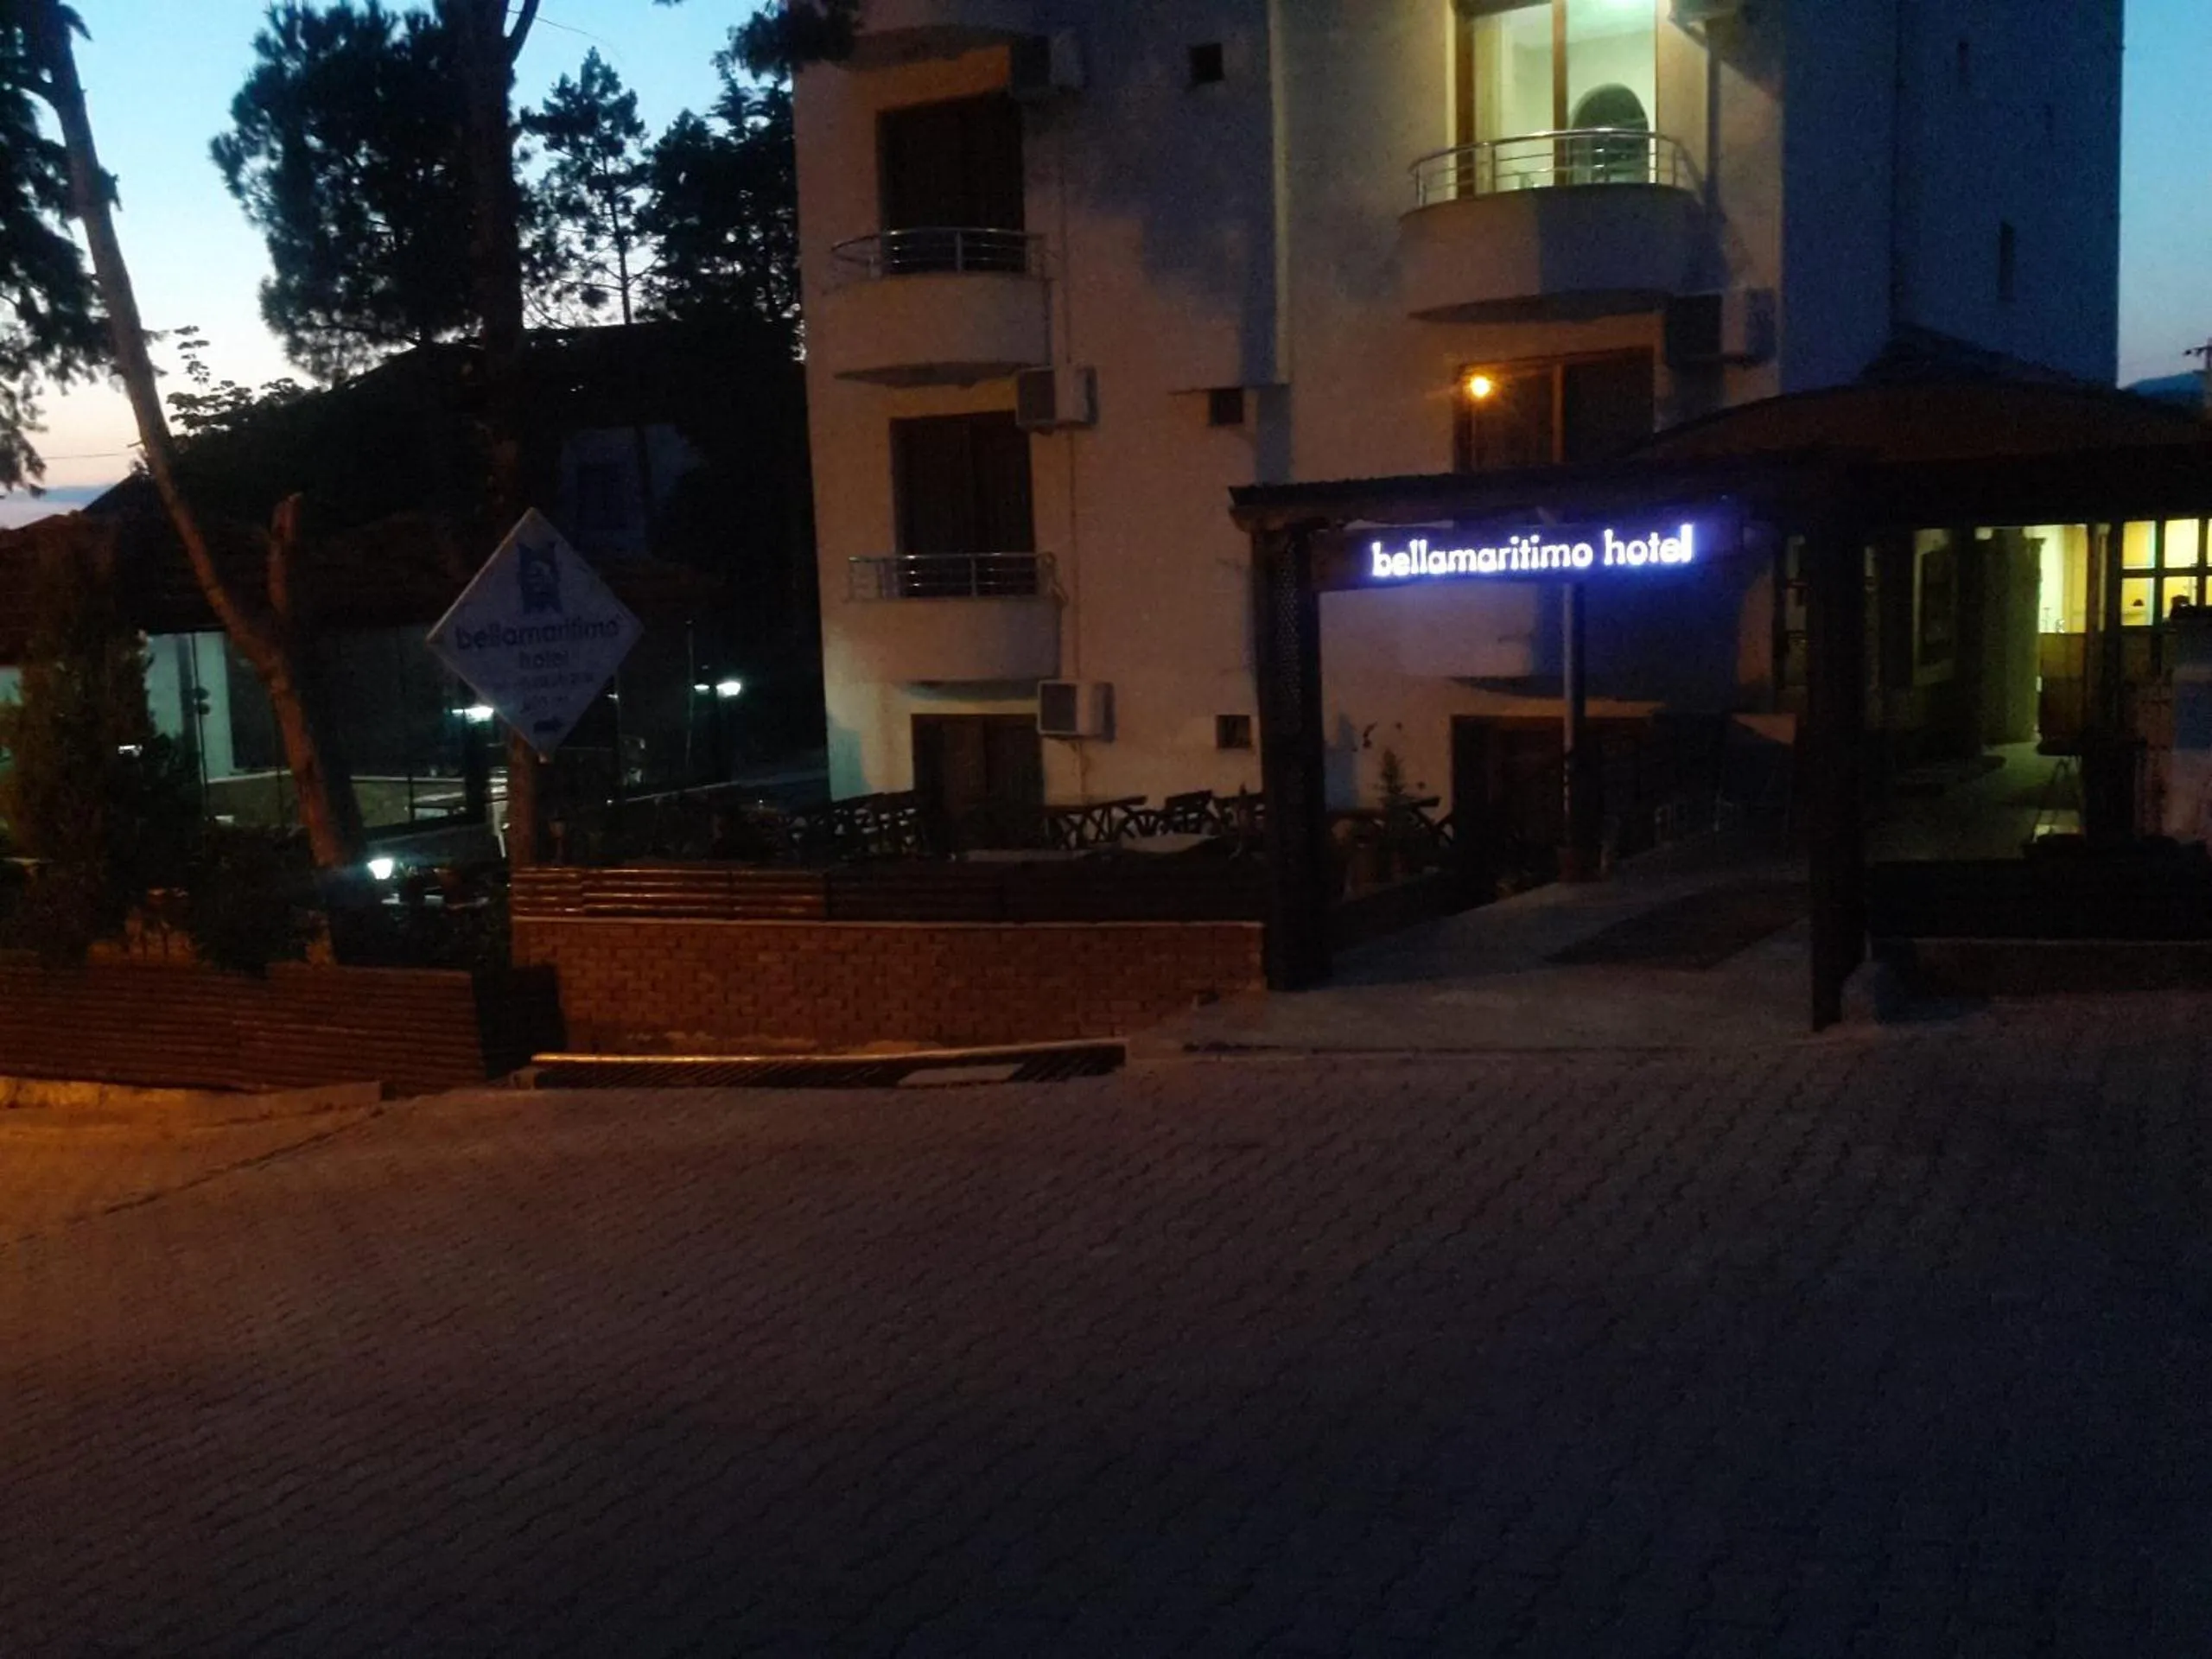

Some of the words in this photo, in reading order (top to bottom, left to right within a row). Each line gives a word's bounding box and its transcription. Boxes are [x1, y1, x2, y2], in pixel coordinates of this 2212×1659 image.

[1370, 534, 1593, 576] bellamaritimo
[1604, 524, 1694, 566] hotel
[455, 616, 620, 650] bellamaritimo
